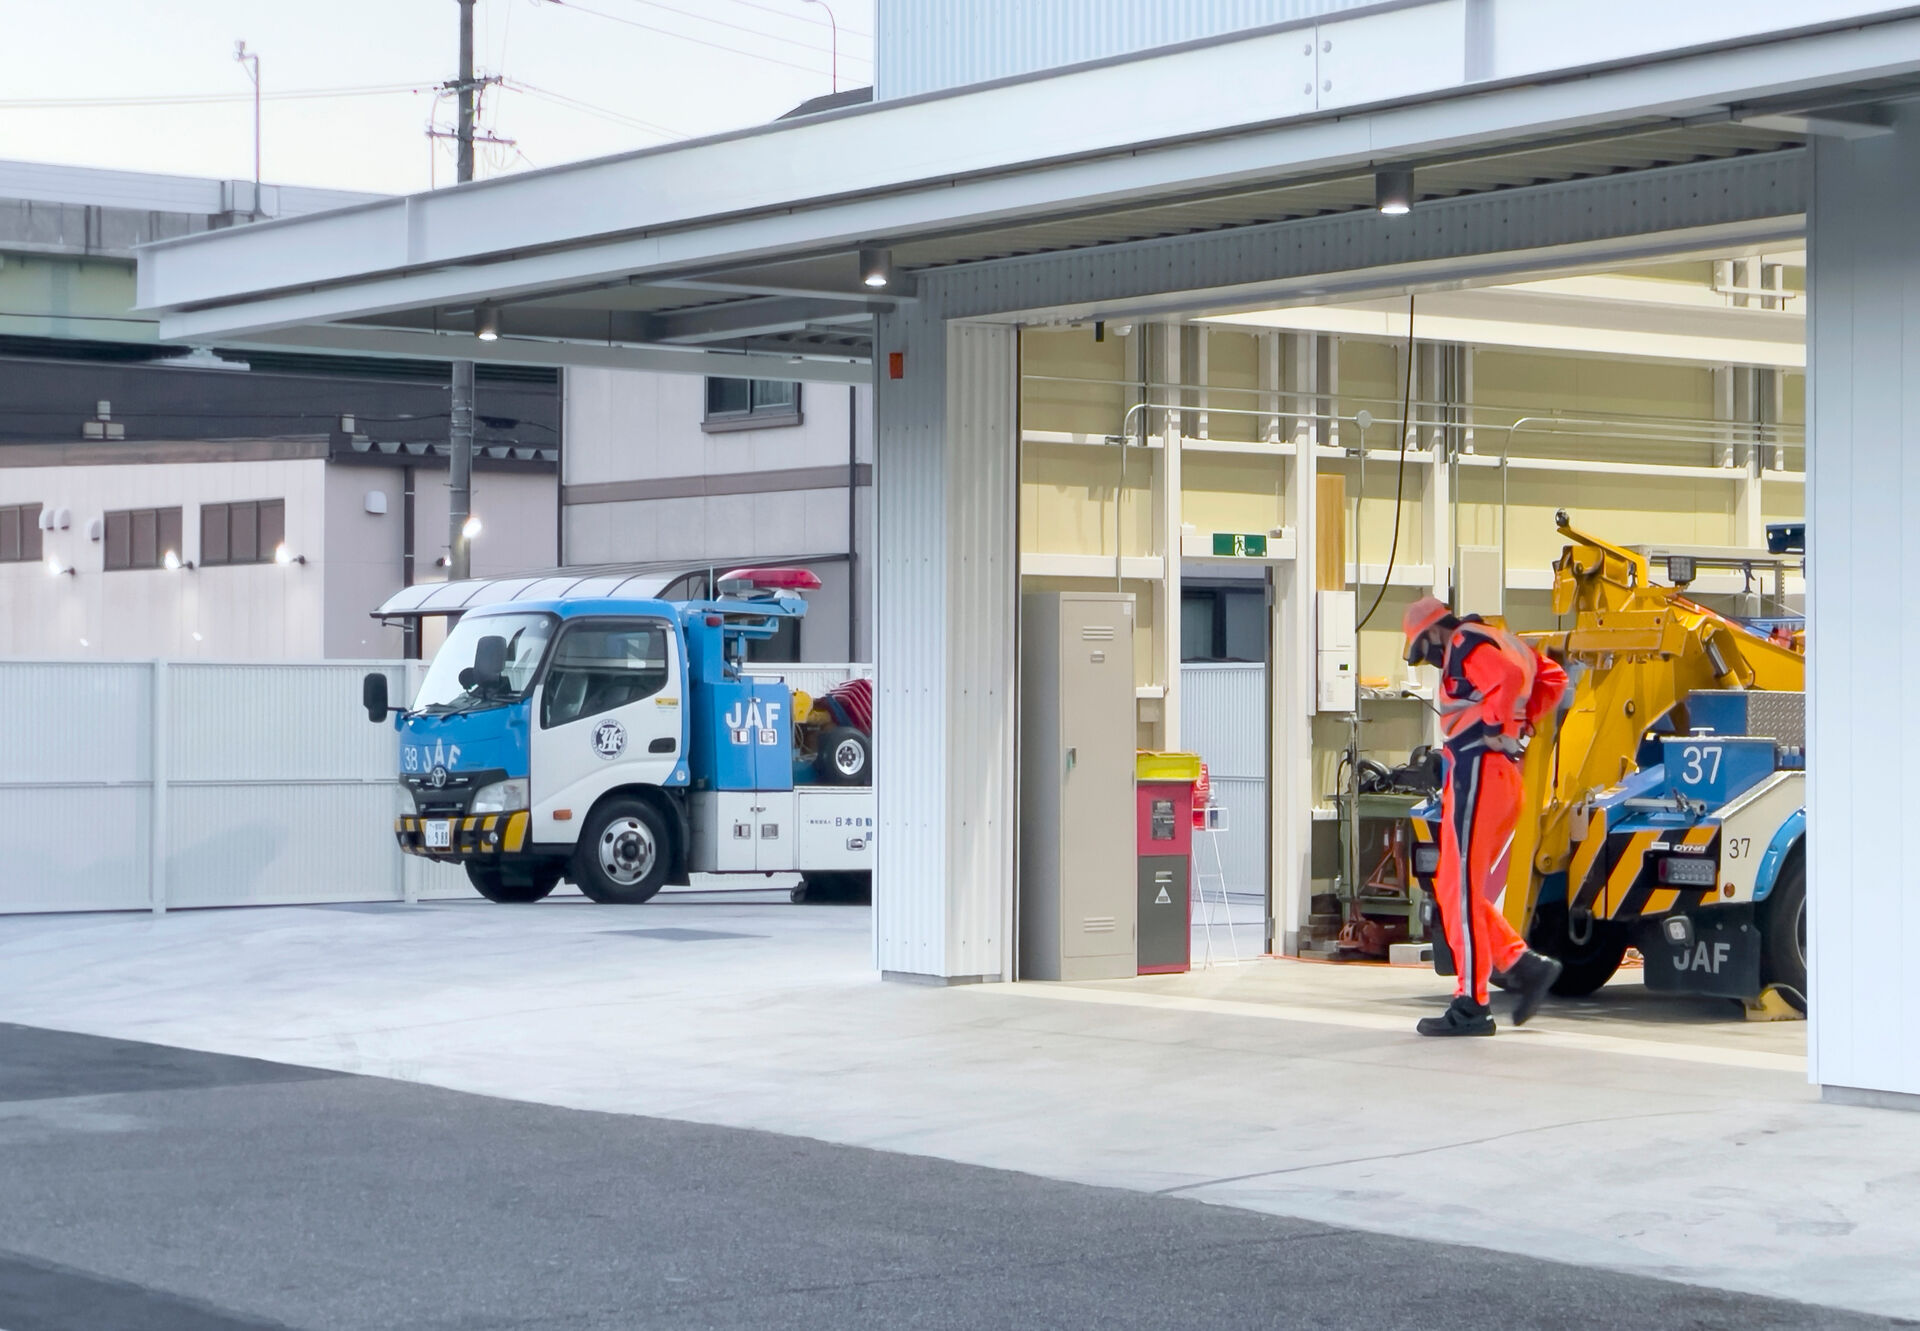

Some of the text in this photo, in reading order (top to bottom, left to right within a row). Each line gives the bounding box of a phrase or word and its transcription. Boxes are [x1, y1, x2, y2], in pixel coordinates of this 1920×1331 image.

[725, 702, 781, 729] JAF
[404, 747, 418, 771] 38
[422, 738, 461, 774] JAF
[1682, 746, 1723, 785] 37
[1729, 837, 1751, 859] 37
[1673, 940, 1731, 974] JAF
